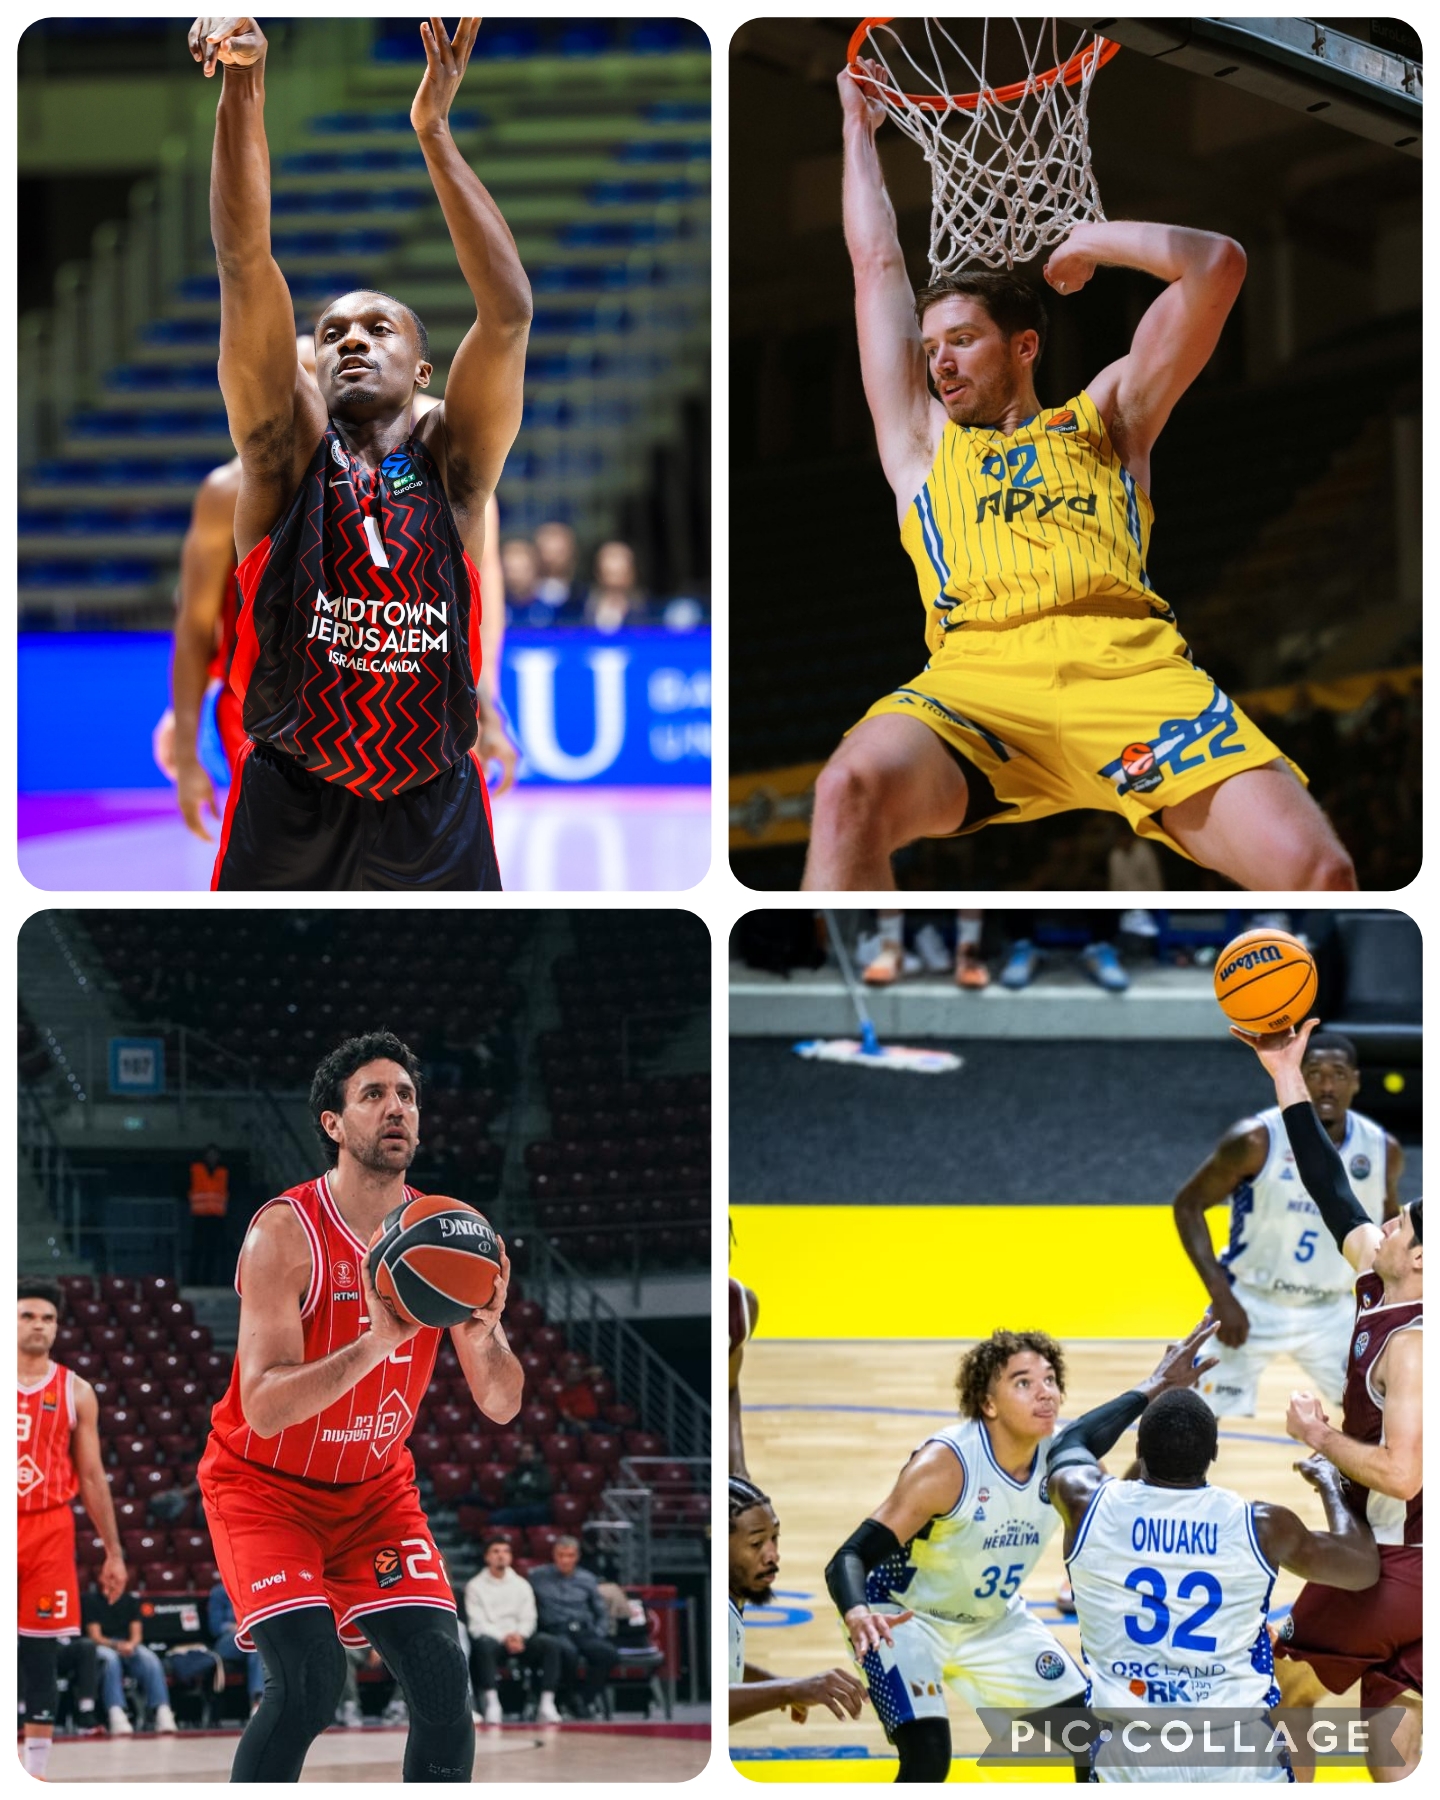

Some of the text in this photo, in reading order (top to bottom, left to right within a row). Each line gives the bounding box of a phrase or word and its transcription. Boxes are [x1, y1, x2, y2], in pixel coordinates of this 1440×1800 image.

[393, 480, 423, 496] EuroCup
[363, 516, 389, 568] 1
[315, 589, 447, 626] MIDTOWN
[307, 615, 448, 653] JERUSALEM
[1159, 711, 1246, 775] 22
[1219, 945, 1284, 982] Wilson
[1268, 1014, 1291, 1029] FIBA
[1294, 1230, 1319, 1263] 5
[333, 1292, 358, 1301] RTMI
[321, 1429, 371, 1444] השקעות
[354, 1415, 373, 1428] בית
[982, 1532, 1040, 1550] HERZLIYA
[1131, 1516, 1218, 1555] ONUAKU
[251, 1570, 287, 1593] nuvei
[974, 1563, 1024, 1599] 35
[54, 1590, 68, 1618] 3
[1124, 1567, 1223, 1652] 32
